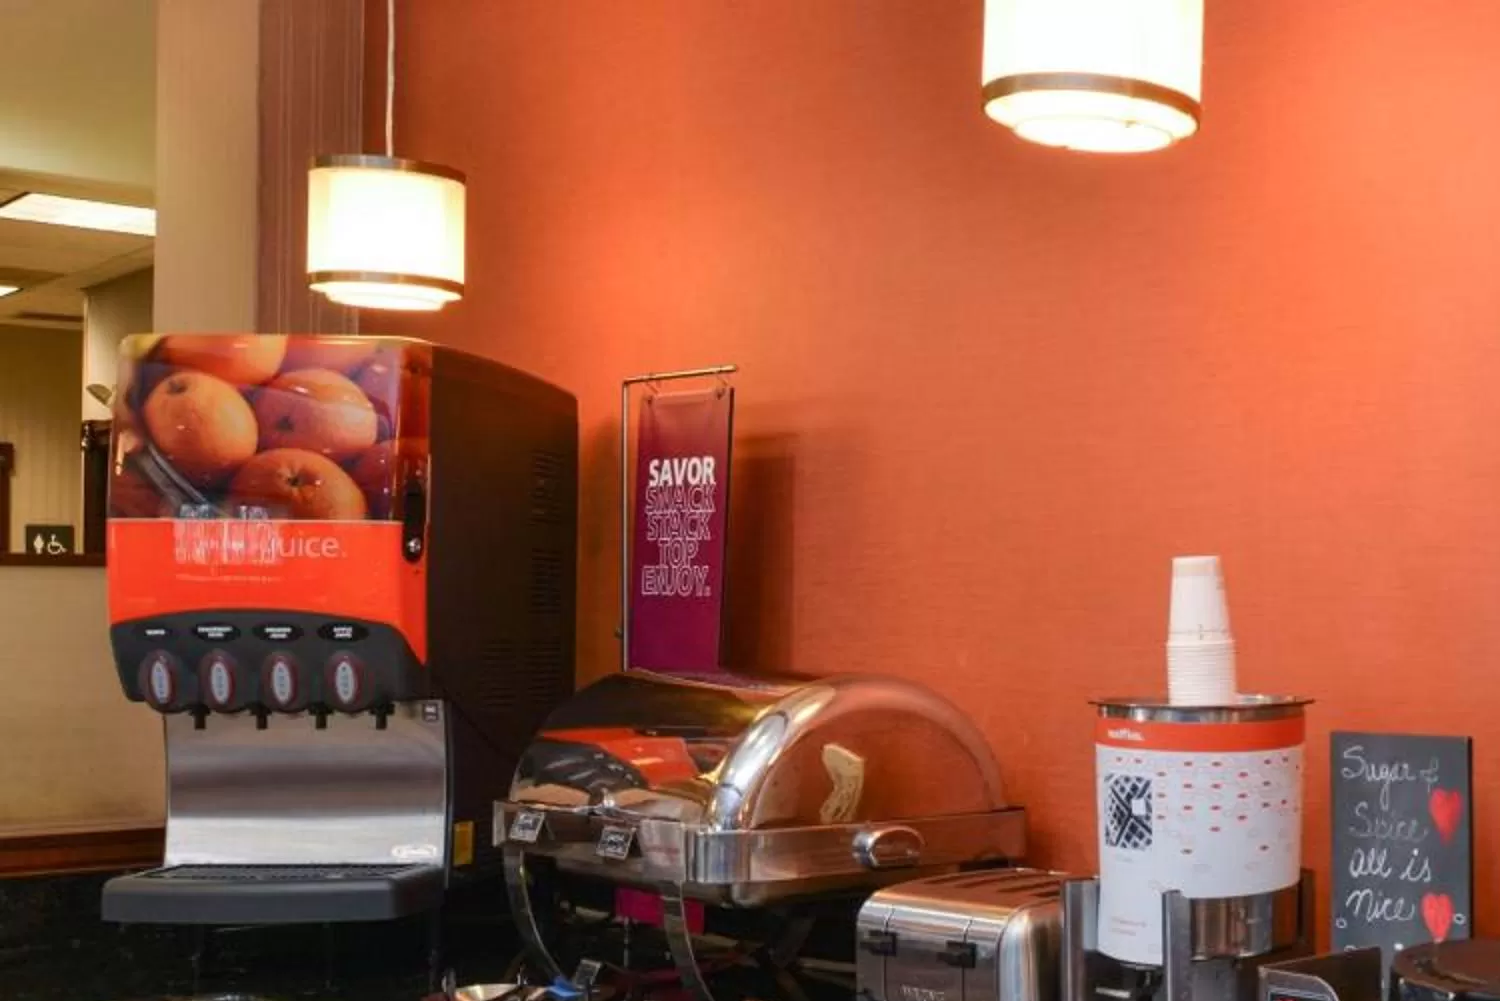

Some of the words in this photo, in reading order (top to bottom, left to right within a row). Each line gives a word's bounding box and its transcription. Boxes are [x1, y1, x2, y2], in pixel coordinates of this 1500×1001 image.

[649, 457, 716, 487] SAVOR
[645, 483, 716, 513] SNACK
[647, 510, 711, 541] STACK
[658, 537, 700, 567] TOP
[641, 565, 711, 597] ENJOY.
[1341, 745, 1417, 811] Sugar
[1400, 848, 1432, 883] is
